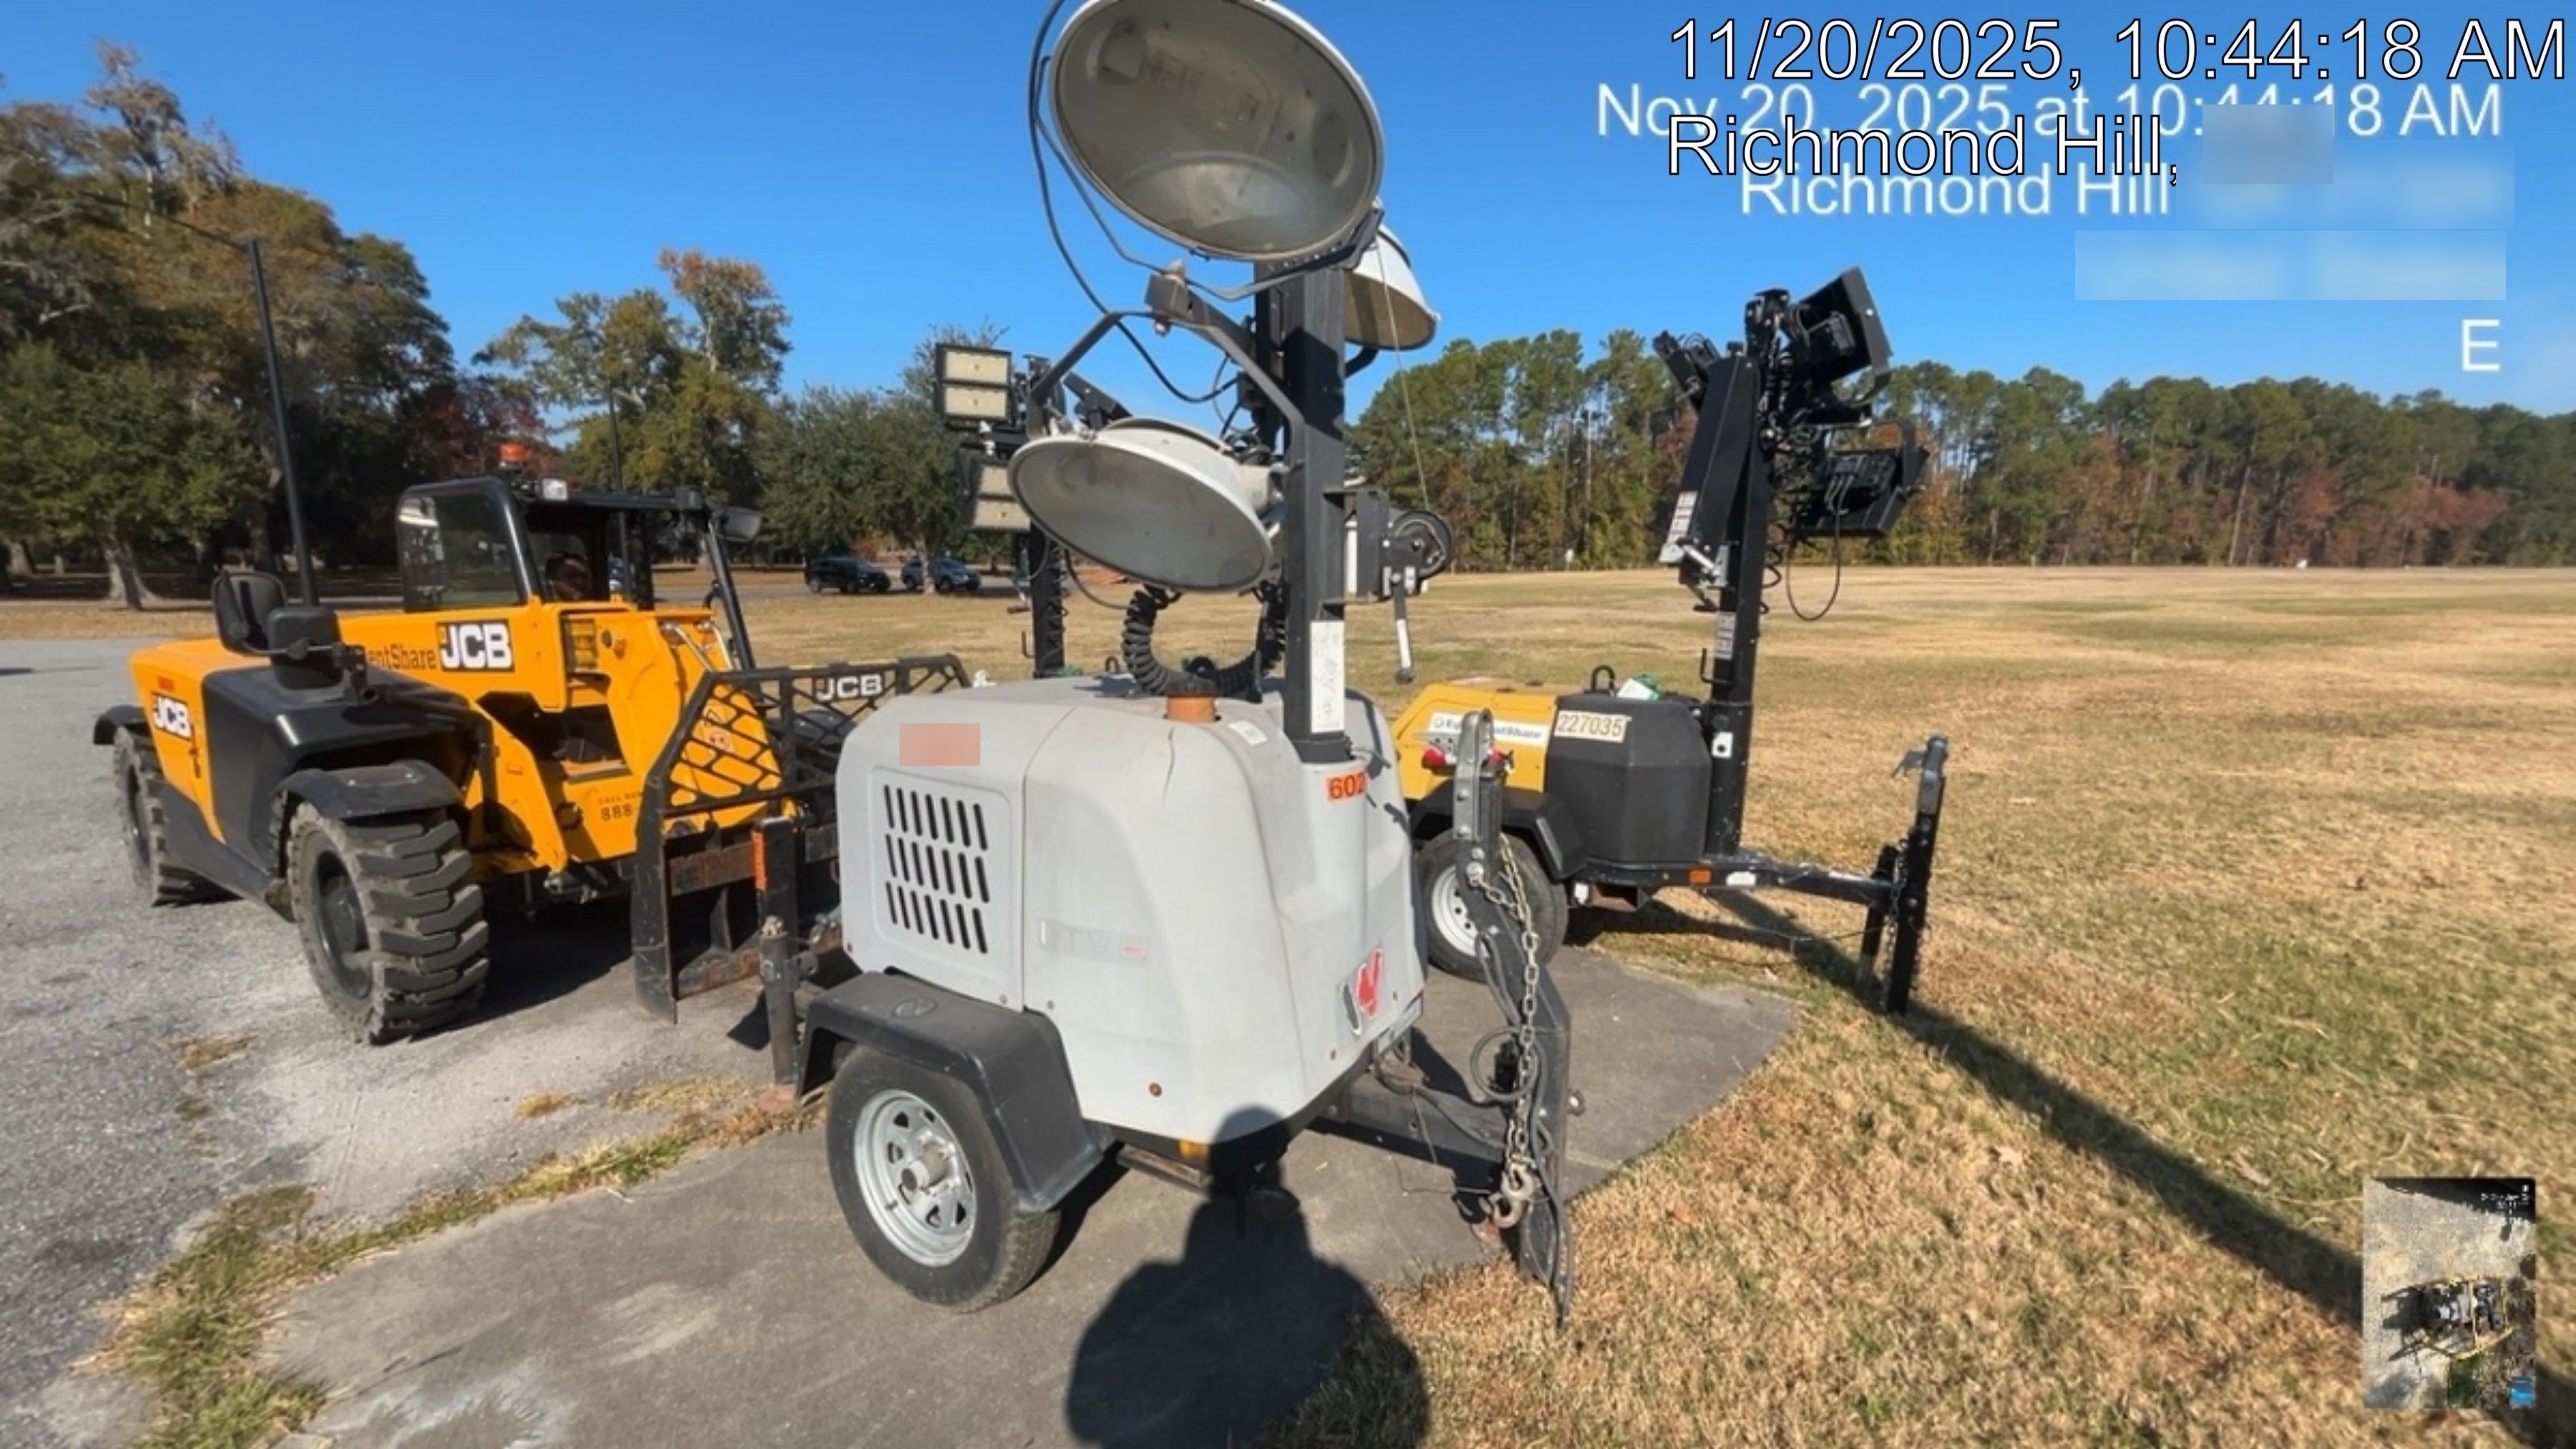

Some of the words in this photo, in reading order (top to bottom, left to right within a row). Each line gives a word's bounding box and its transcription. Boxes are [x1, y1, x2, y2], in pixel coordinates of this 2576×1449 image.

[439, 623, 513, 669] JCB
[815, 675, 884, 701] JCB
[153, 696, 192, 738] JCB
[1557, 714, 1623, 737] 227035
